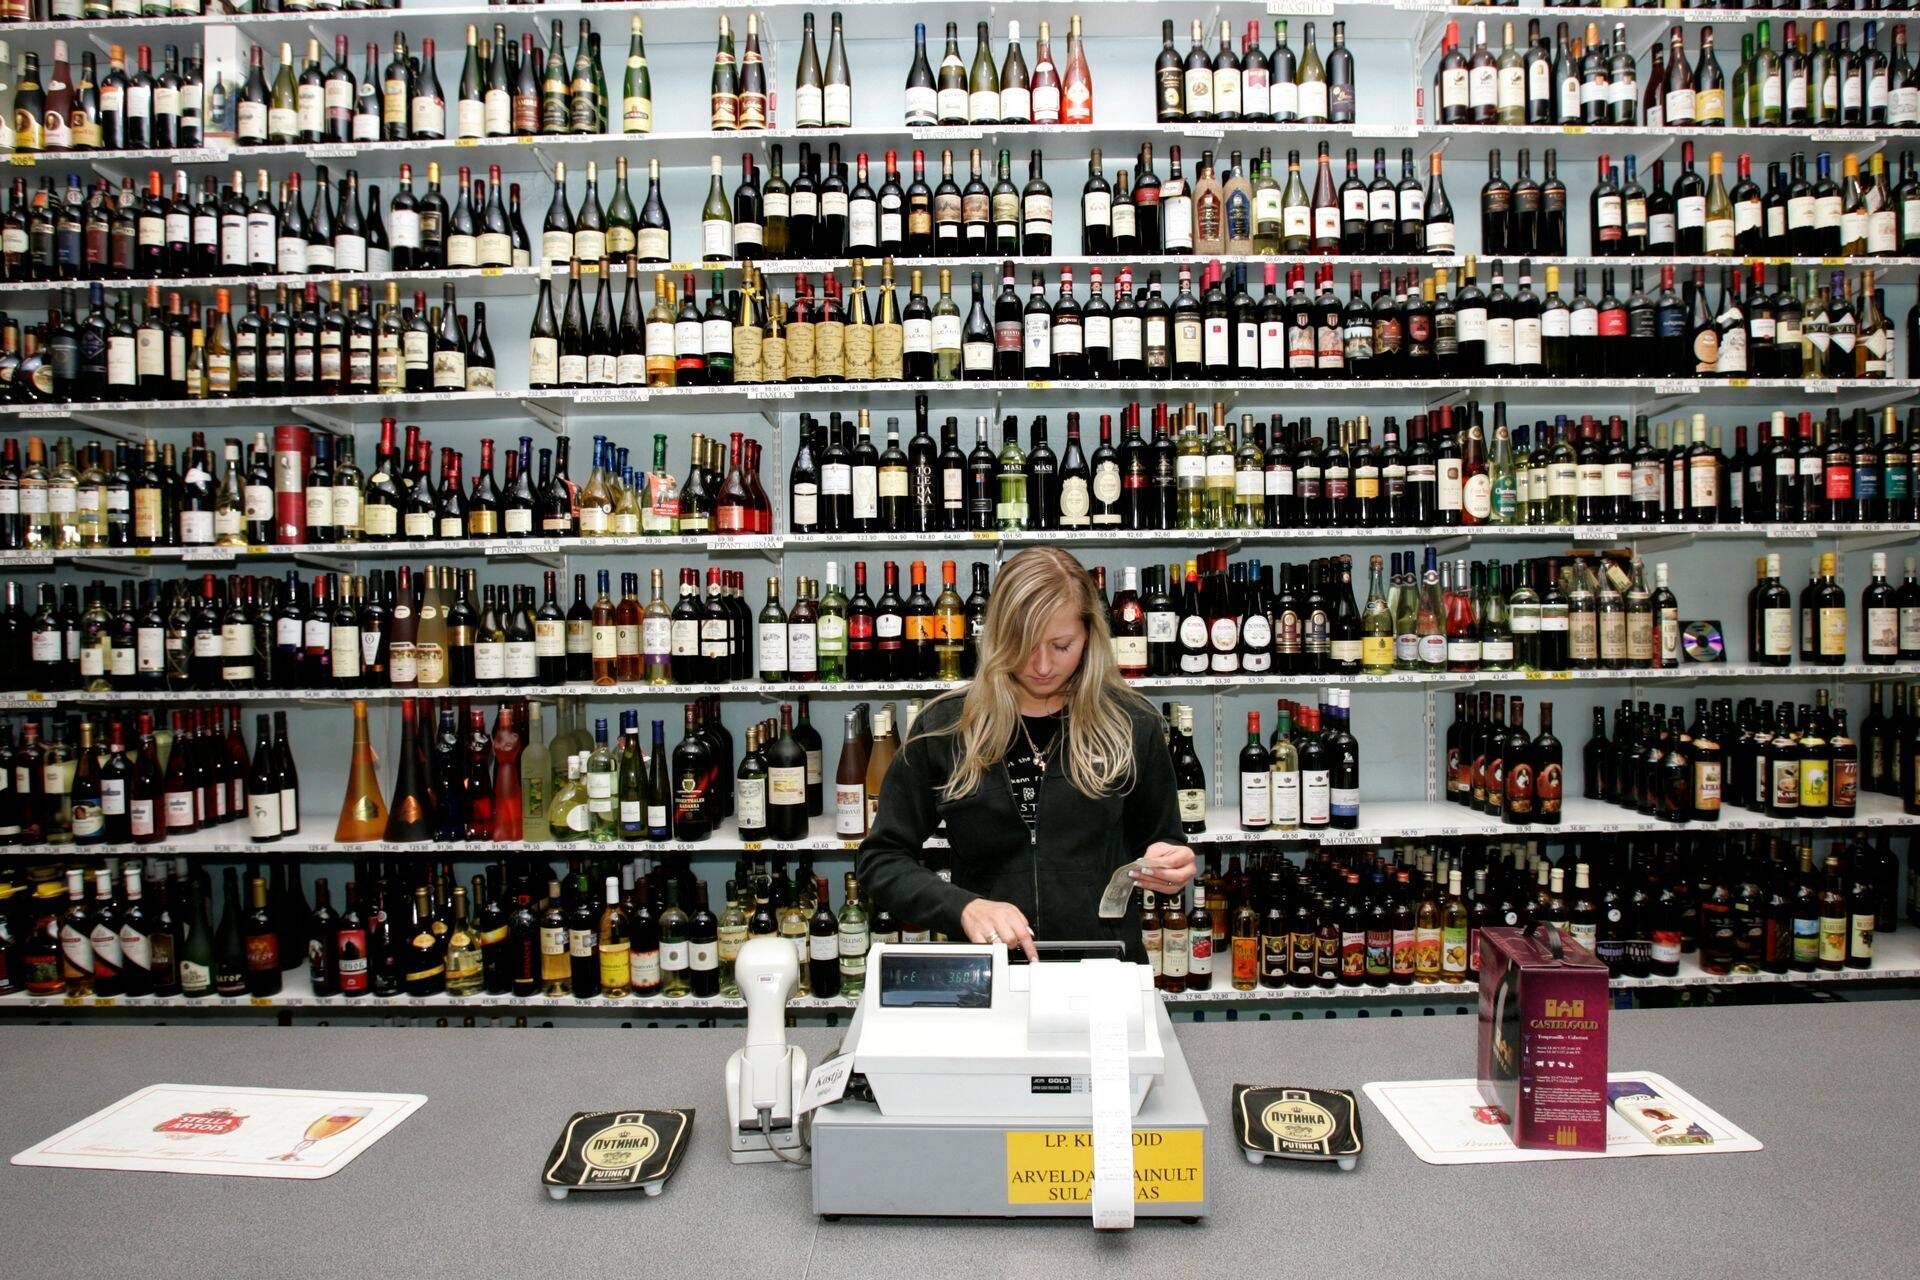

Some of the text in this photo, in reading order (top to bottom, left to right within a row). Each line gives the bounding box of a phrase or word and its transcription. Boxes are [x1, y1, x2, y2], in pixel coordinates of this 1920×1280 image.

[1530, 1019, 1599, 1030] CASTELGOLD
[179, 1117, 232, 1125] STELLA
[1272, 1112, 1325, 1125] ПУТИНКА
[168, 1123, 225, 1131] ARTOIS
[593, 1137, 648, 1150] ПУТИНКА
[1045, 1134, 1068, 1147] LP.
[1282, 1140, 1320, 1150] PUTINKA
[591, 1169, 630, 1178] PUTINKA
